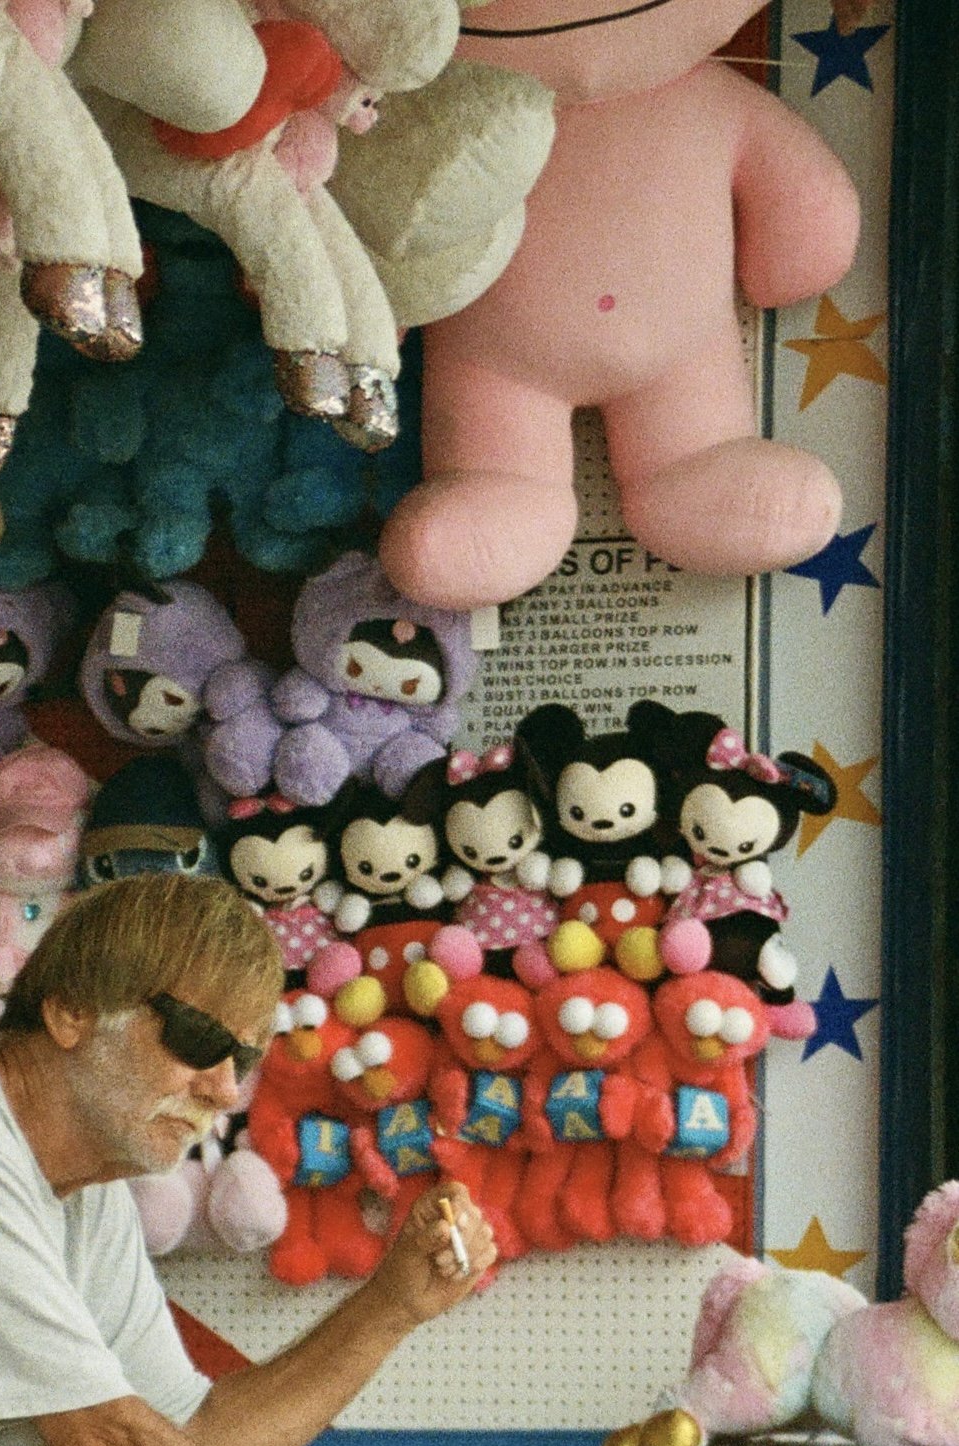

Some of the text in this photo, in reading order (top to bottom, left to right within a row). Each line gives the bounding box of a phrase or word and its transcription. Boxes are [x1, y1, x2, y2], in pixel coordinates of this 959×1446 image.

[589, 548, 634, 576] OF
[599, 579, 672, 593] ADVANCE
[528, 599, 560, 611] ANY
[575, 595, 659, 609] BALLOONS
[538, 612, 589, 625] SMALL
[594, 611, 638, 623] PRIZE
[540, 627, 624, 641] BALLOONS
[628, 625, 657, 637] TOP
[662, 624, 698, 636] ROW
[538, 642, 600, 655] LARGER
[605, 640, 650, 653] PRIZE
[495, 659, 534, 672] WINS
[540, 658, 568, 671] TOP
[573, 657, 607, 669] ROW
[611, 656, 626, 667] IN
[631, 653, 733, 667] SUCCESSION
[482, 672, 582, 687] WINS CHOICE
[483, 689, 523, 702] BUST
[540, 686, 623, 700] BALLOONS
[628, 685, 657, 697] TOP
[662, 683, 697, 696] ROW
[483, 720, 517, 733] PLA
[685, 1093, 724, 1130] A
